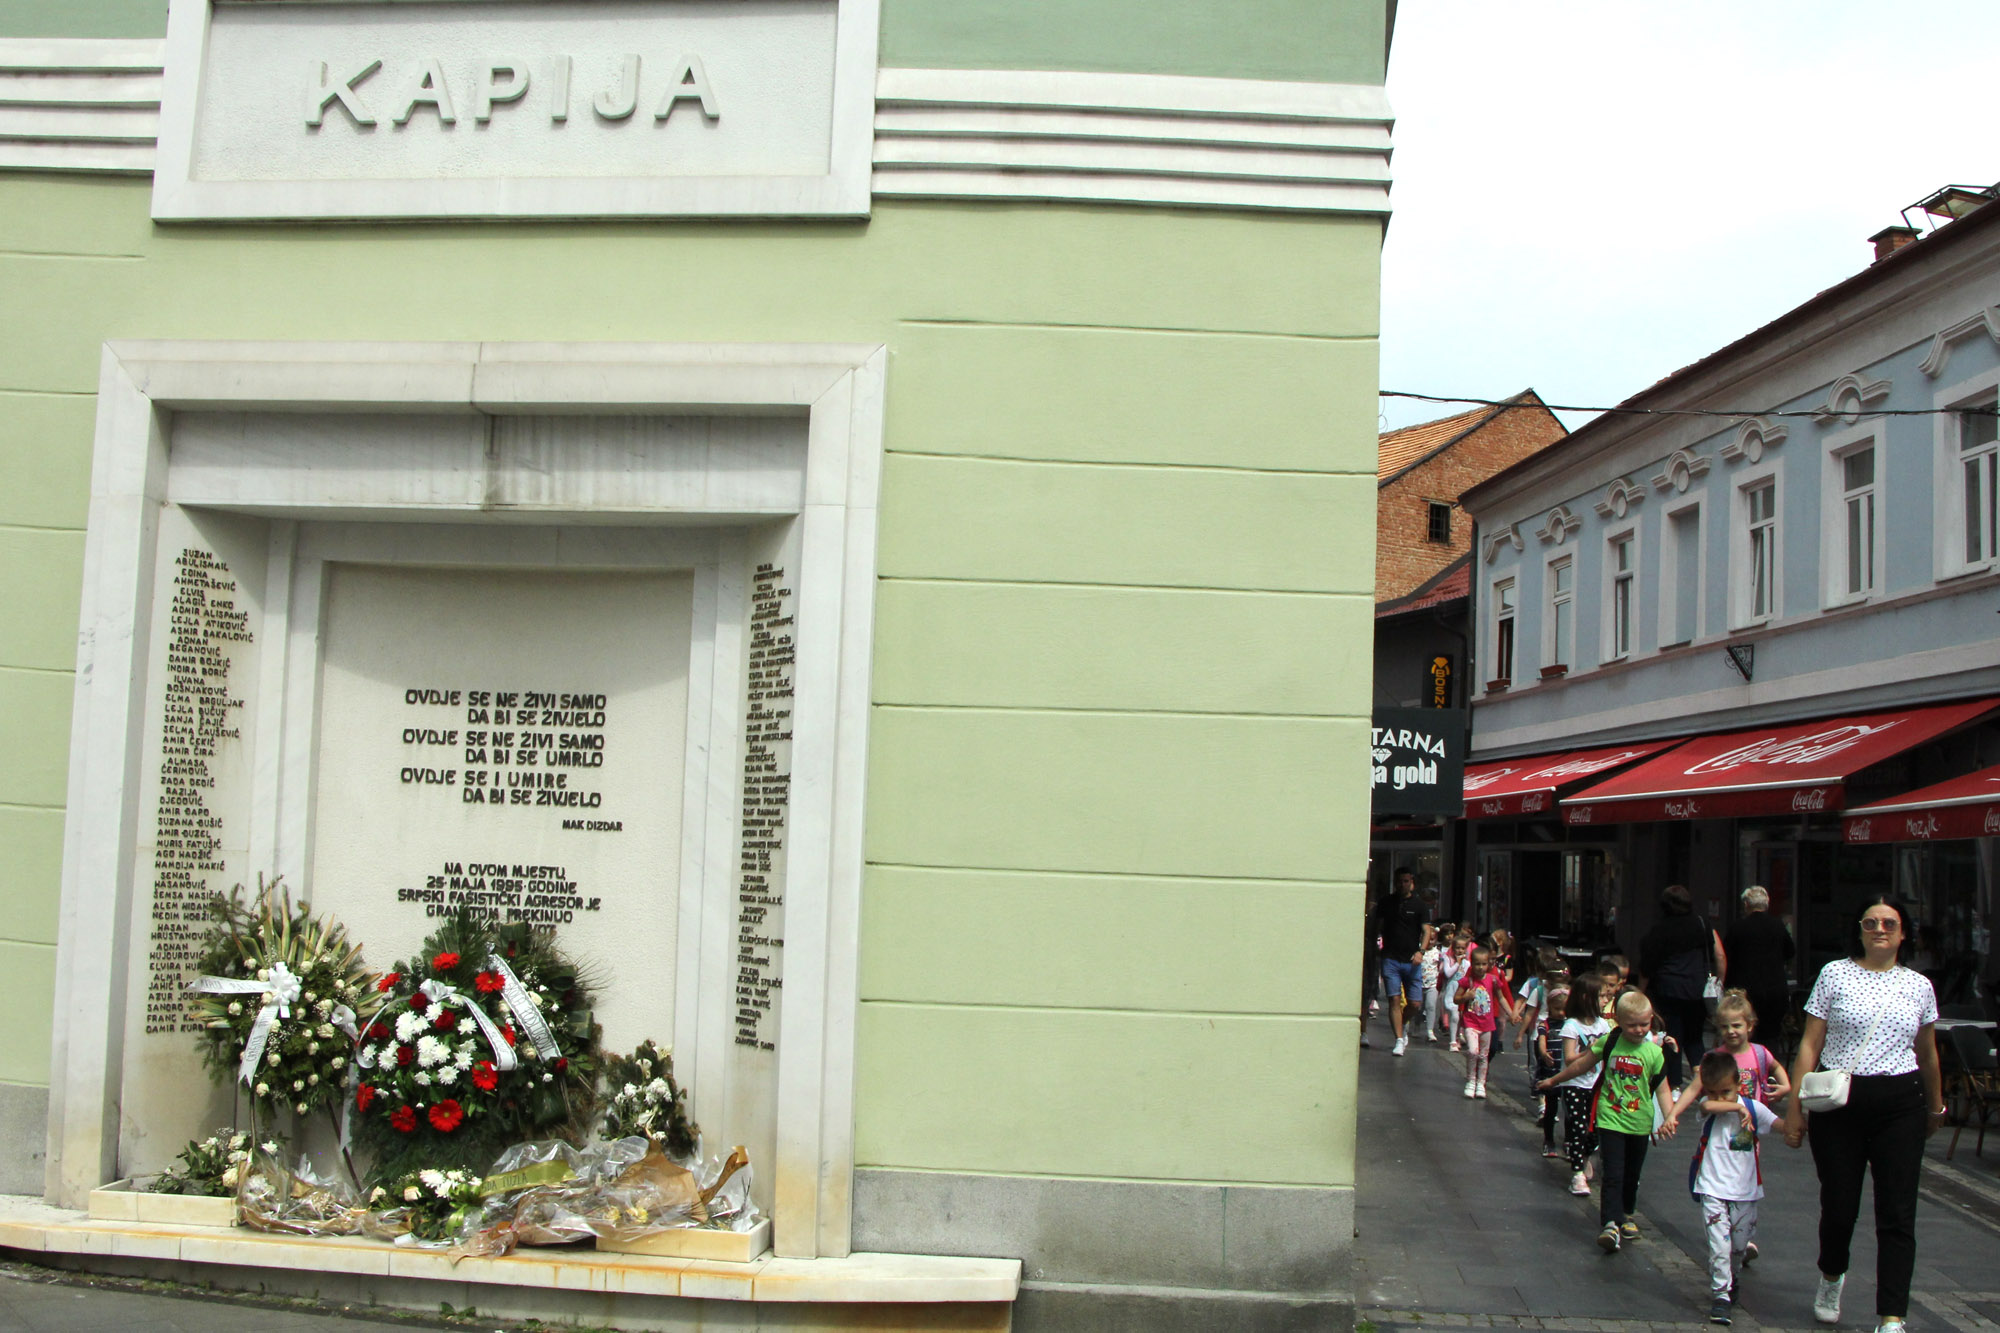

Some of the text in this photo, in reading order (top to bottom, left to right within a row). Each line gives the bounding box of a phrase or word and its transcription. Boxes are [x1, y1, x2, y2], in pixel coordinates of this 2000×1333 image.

[304, 53, 721, 128] KAPIJA
[183, 549, 212, 559] SUZAN
[181, 568, 208, 578] EDINA
[180, 587, 205, 598] ELVIS
[211, 600, 234, 609] ENKO
[172, 606, 200, 615] ADMIR
[171, 616, 199, 626] LEJLA
[170, 626, 198, 635] ASMIR
[177, 636, 208, 645] ADNAN
[168, 654, 196, 664] DAMIR
[165, 694, 190, 703] ELMA
[405, 689, 607, 710] OVDJE SE NE ŽIVI SAMO
[165, 704, 193, 714] LEJLA
[164, 715, 194, 725] SANJA
[468, 709, 606, 727] DA BI SE ŽIVJELO
[163, 725, 195, 735] SELMA
[163, 736, 185, 744] AMIR
[402, 728, 605, 750] OVDJE SE NE ŽIVI SAMO
[162, 746, 189, 755] SAMIR
[168, 757, 205, 767] ALMASA
[466, 748, 603, 767] DA BI SE UMRLO
[400, 768, 567, 789] OVDJE SE I UMIRE
[1393, 757, 1438, 790] gold
[463, 788, 602, 808] DA BI SE ŽIVJELO
[158, 807, 180, 816] AMIR
[158, 817, 194, 826] SUZANA
[562, 820, 623, 832] MAK DIZDAR
[156, 840, 183, 848] MURIS
[156, 850, 175, 858] AGO
[445, 862, 463, 876] NA
[469, 864, 507, 877] OVOM
[450, 877, 486, 891] MAJA
[528, 880, 577, 894] GODINE
[398, 889, 601, 911] SRPSKI FAŠISTIČKI AGRESOR JE
[427, 904, 573, 923] GRANTOM PREKINUO
[157, 924, 189, 932] HASAN
[149, 992, 173, 1000] AZUR
